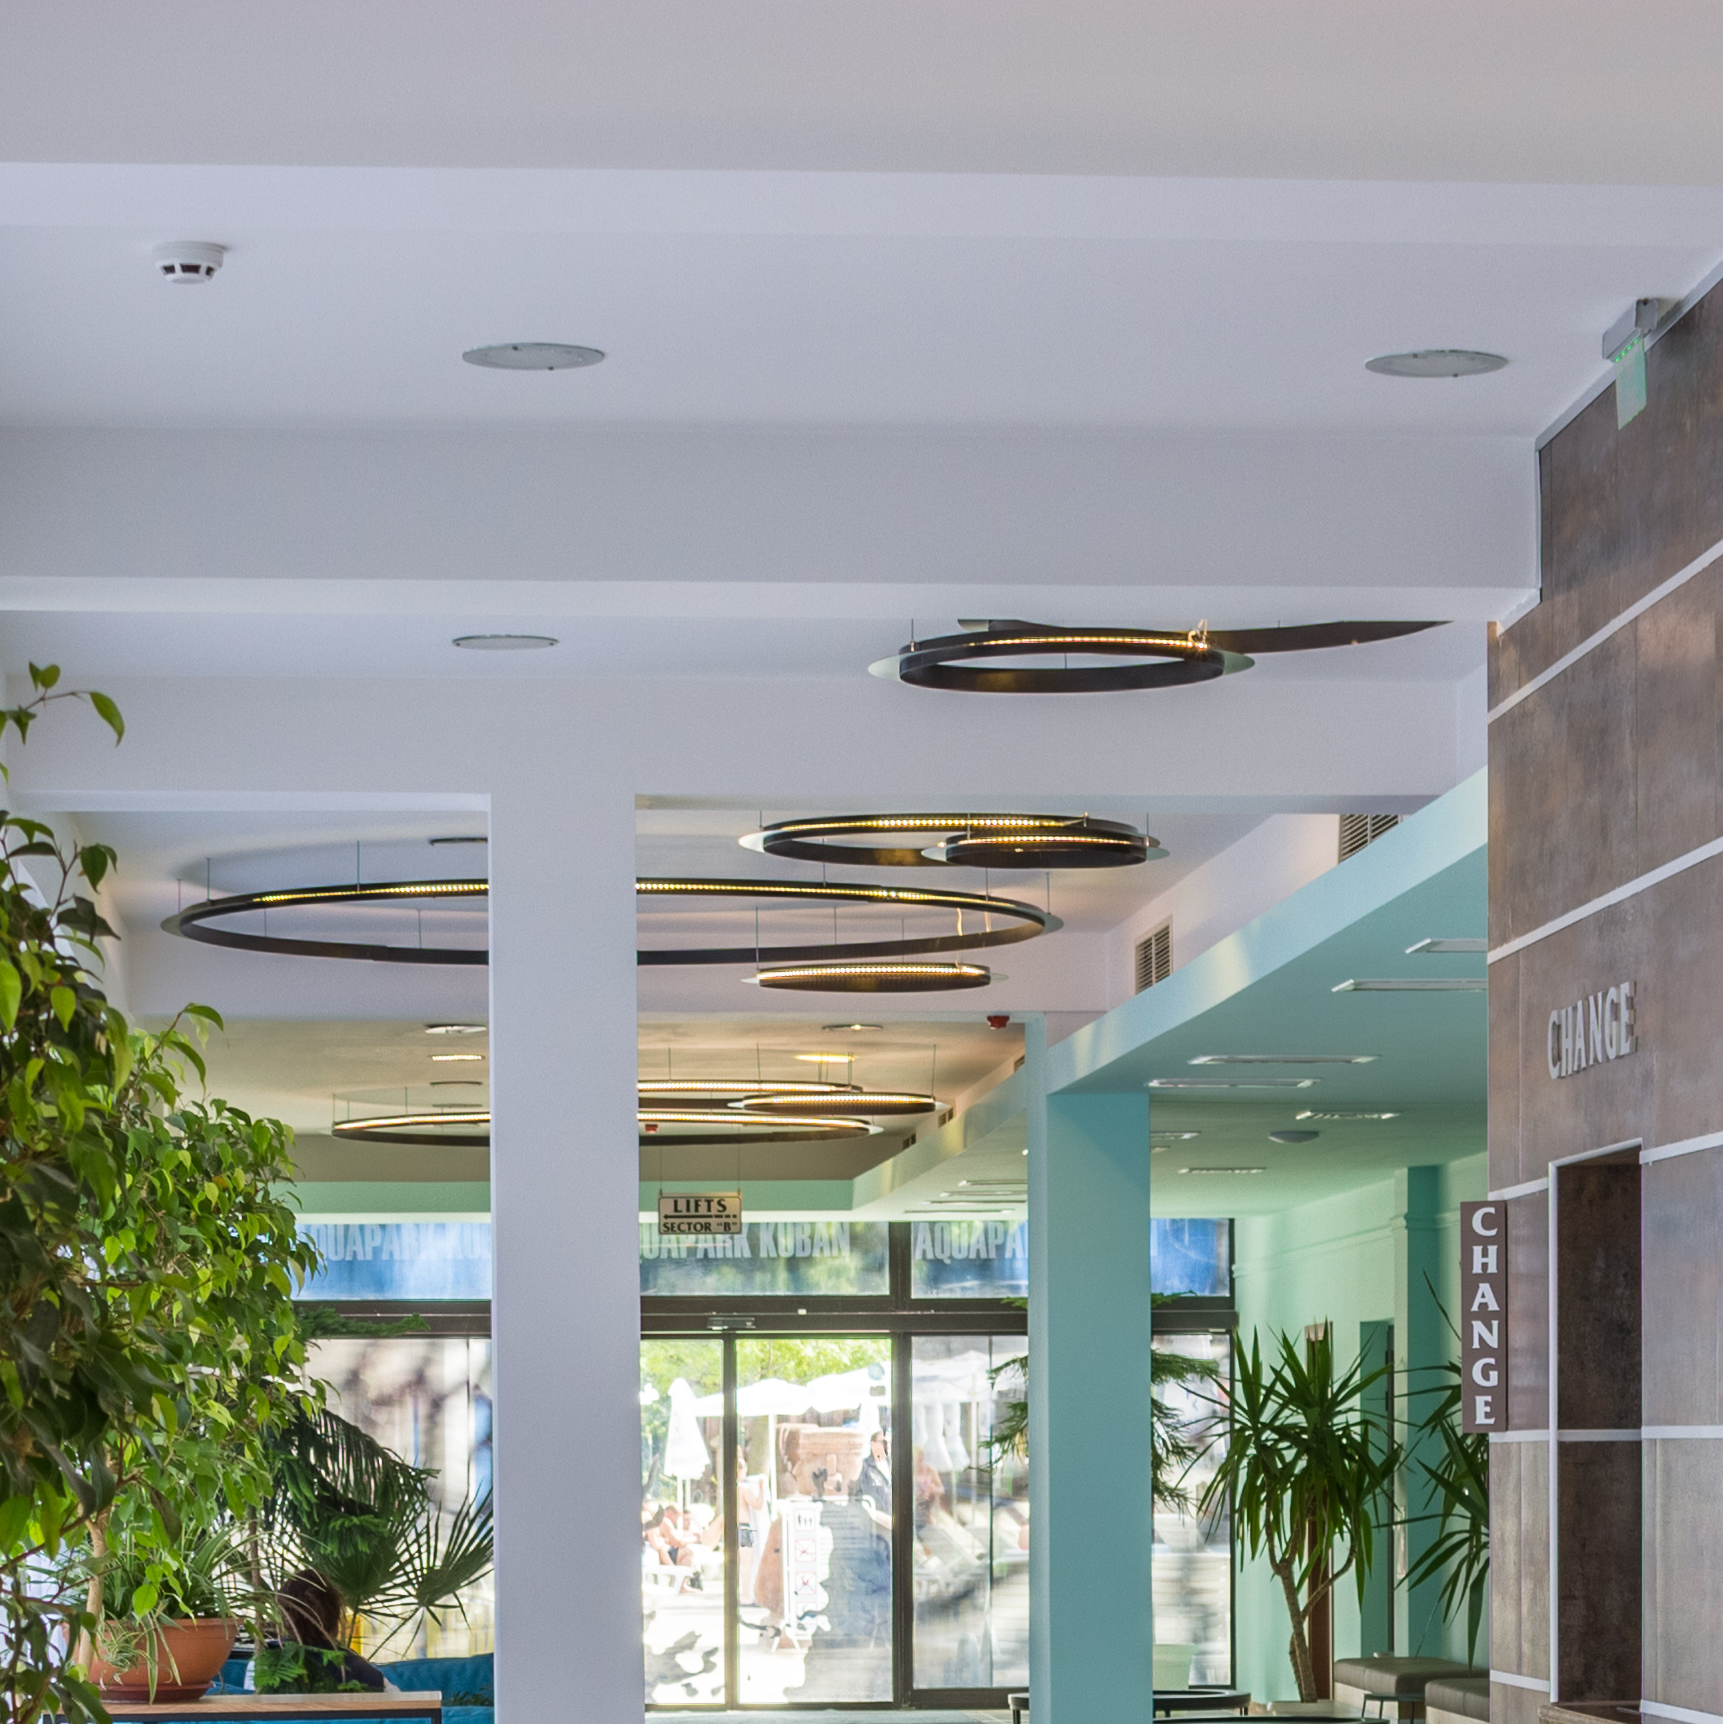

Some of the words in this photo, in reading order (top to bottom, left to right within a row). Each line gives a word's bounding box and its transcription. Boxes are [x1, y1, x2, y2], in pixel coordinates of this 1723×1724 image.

[1548, 981, 1637, 1079] CHANGE
[673, 1198, 727, 1213] LIFTS
[663, 1222, 712, 1233] SECTOR
[759, 1222, 851, 1258] KUBAN
[1470, 1206, 1500, 1425] CHANGE
